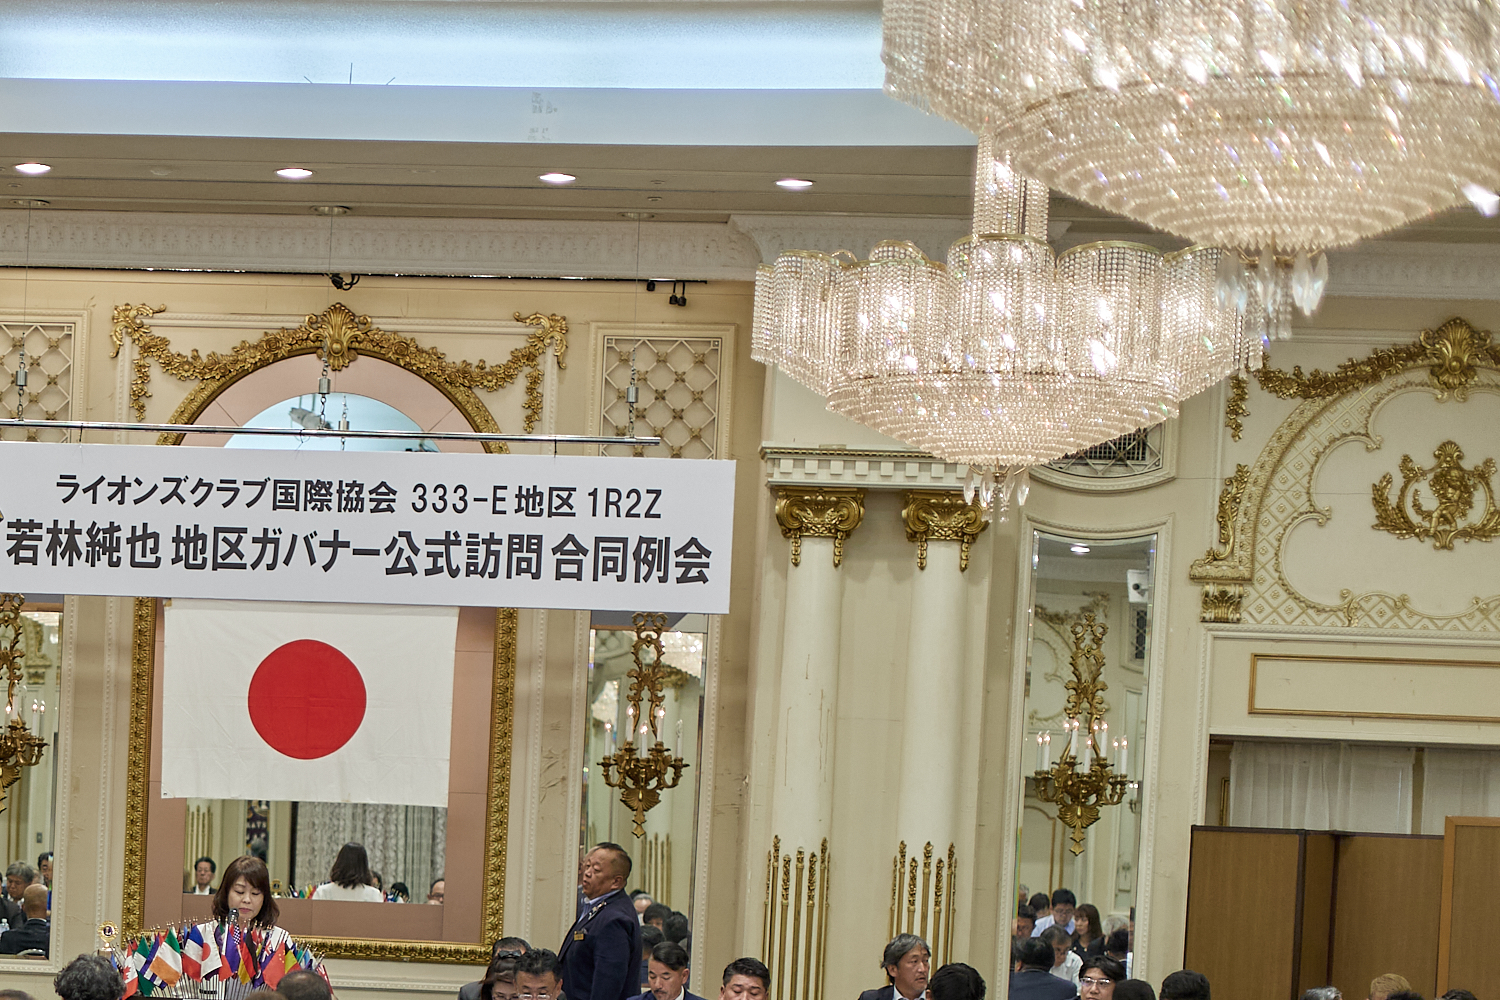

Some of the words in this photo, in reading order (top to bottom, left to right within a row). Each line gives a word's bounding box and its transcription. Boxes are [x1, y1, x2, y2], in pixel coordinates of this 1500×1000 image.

[56, 474, 398, 514] ライオンズクラブ国際協会
[587, 486, 663, 519] 1R2Z
